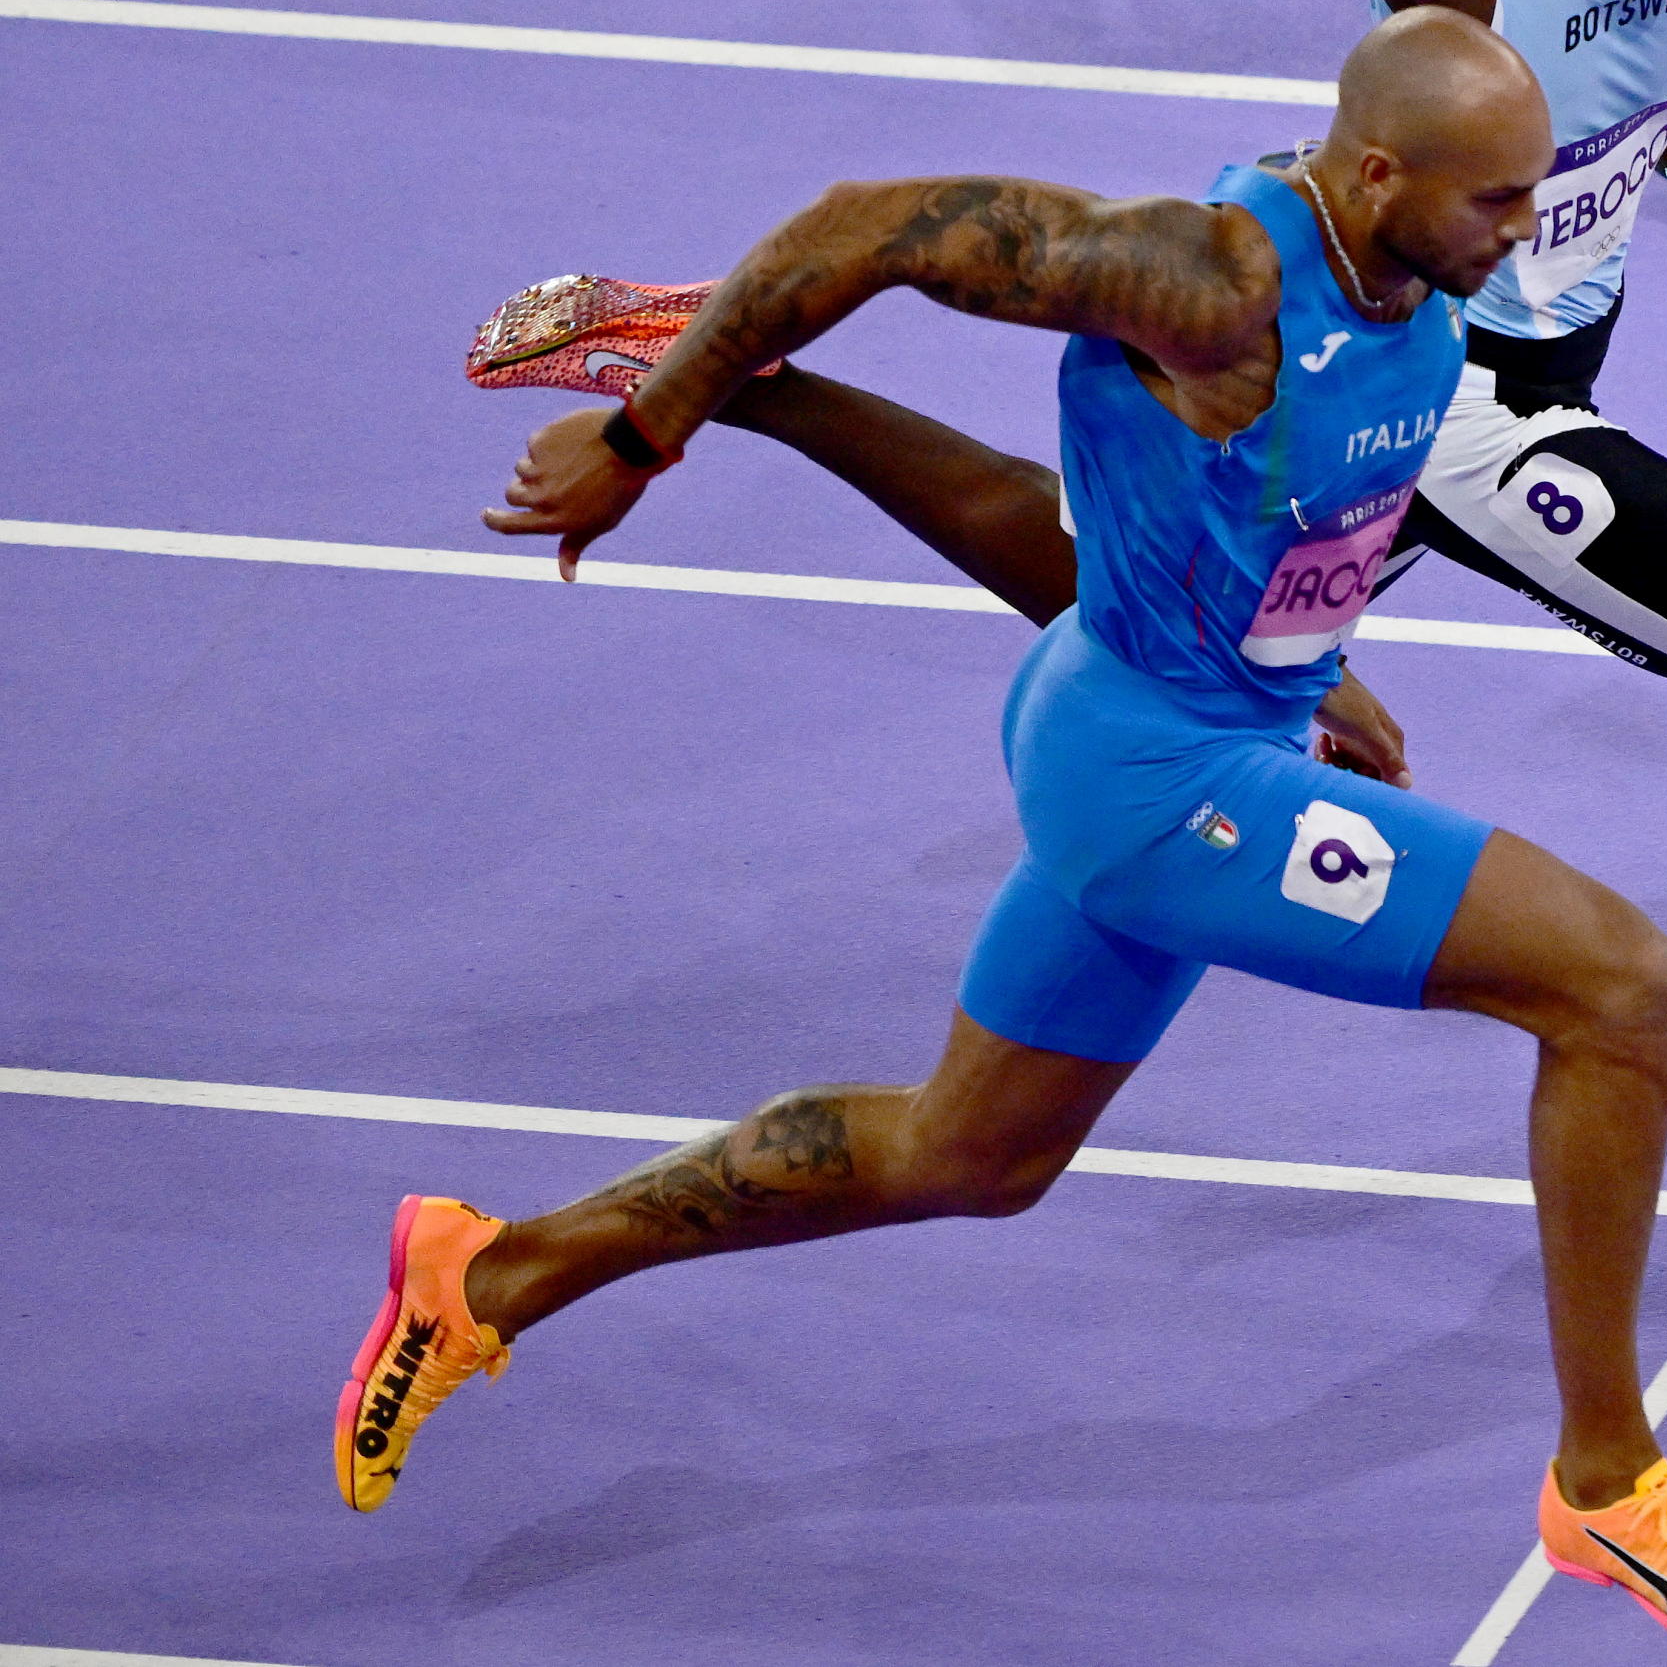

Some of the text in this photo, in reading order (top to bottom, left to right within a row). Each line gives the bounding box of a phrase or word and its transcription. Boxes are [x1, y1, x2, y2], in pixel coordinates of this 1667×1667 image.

[1574, 129, 1621, 162] PARIS
[1345, 408, 1437, 464] ITALIA
[1526, 481, 1584, 535] 8
